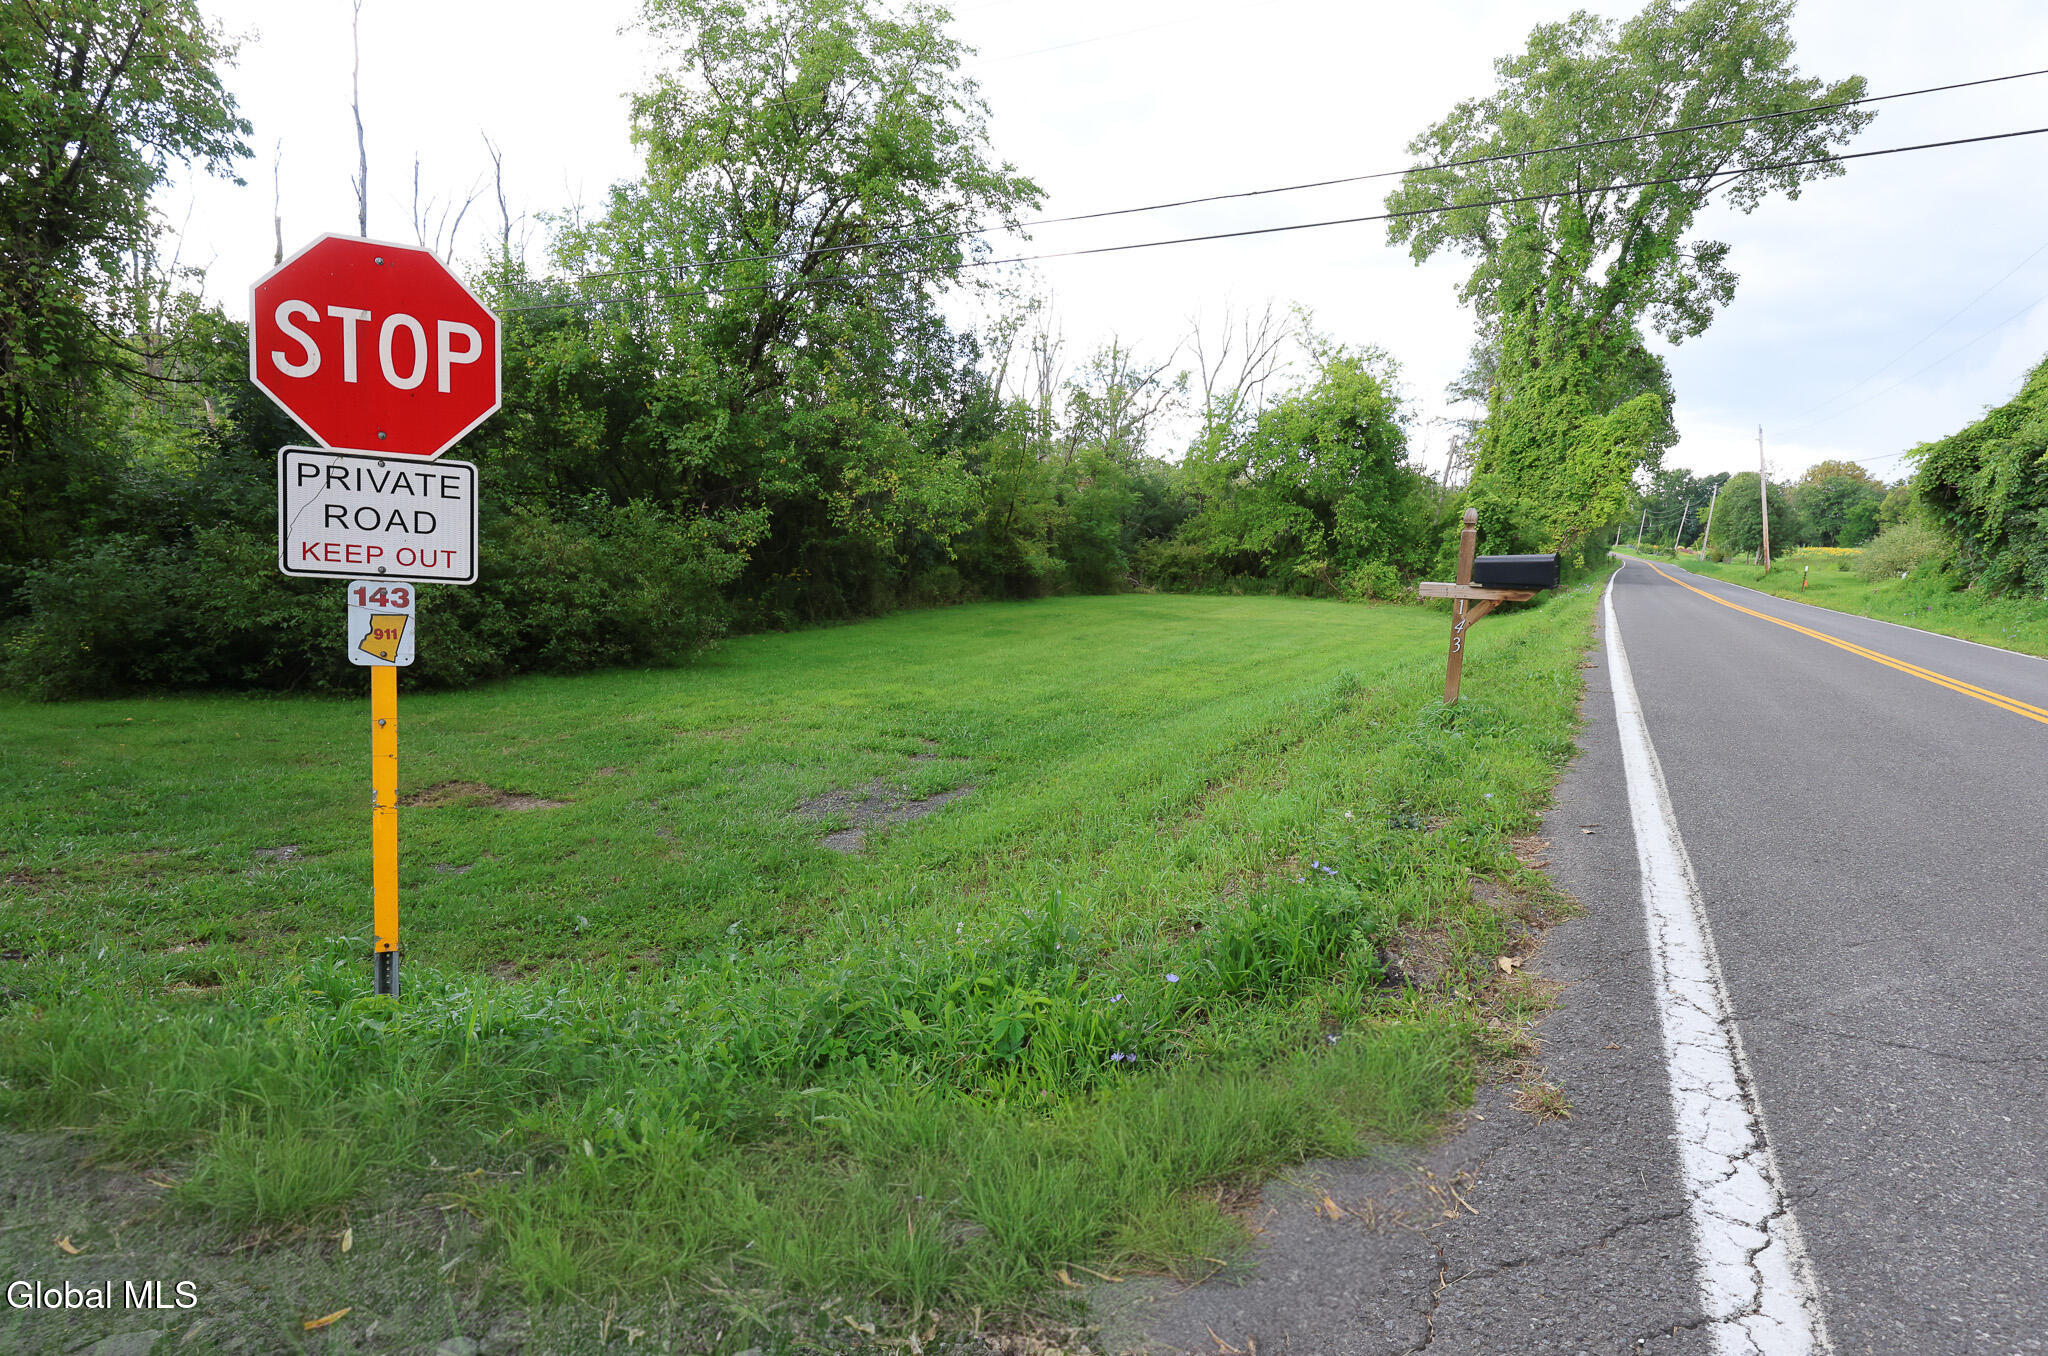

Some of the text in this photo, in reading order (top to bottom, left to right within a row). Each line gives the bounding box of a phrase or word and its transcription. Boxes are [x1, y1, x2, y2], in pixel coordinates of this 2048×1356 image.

[271, 300, 483, 394] STOP
[297, 462, 461, 500] PRIVATE
[324, 504, 437, 535] ROAD
[302, 541, 457, 569] KEEP OUT
[353, 586, 410, 608] 143
[373, 628, 398, 640] 911
